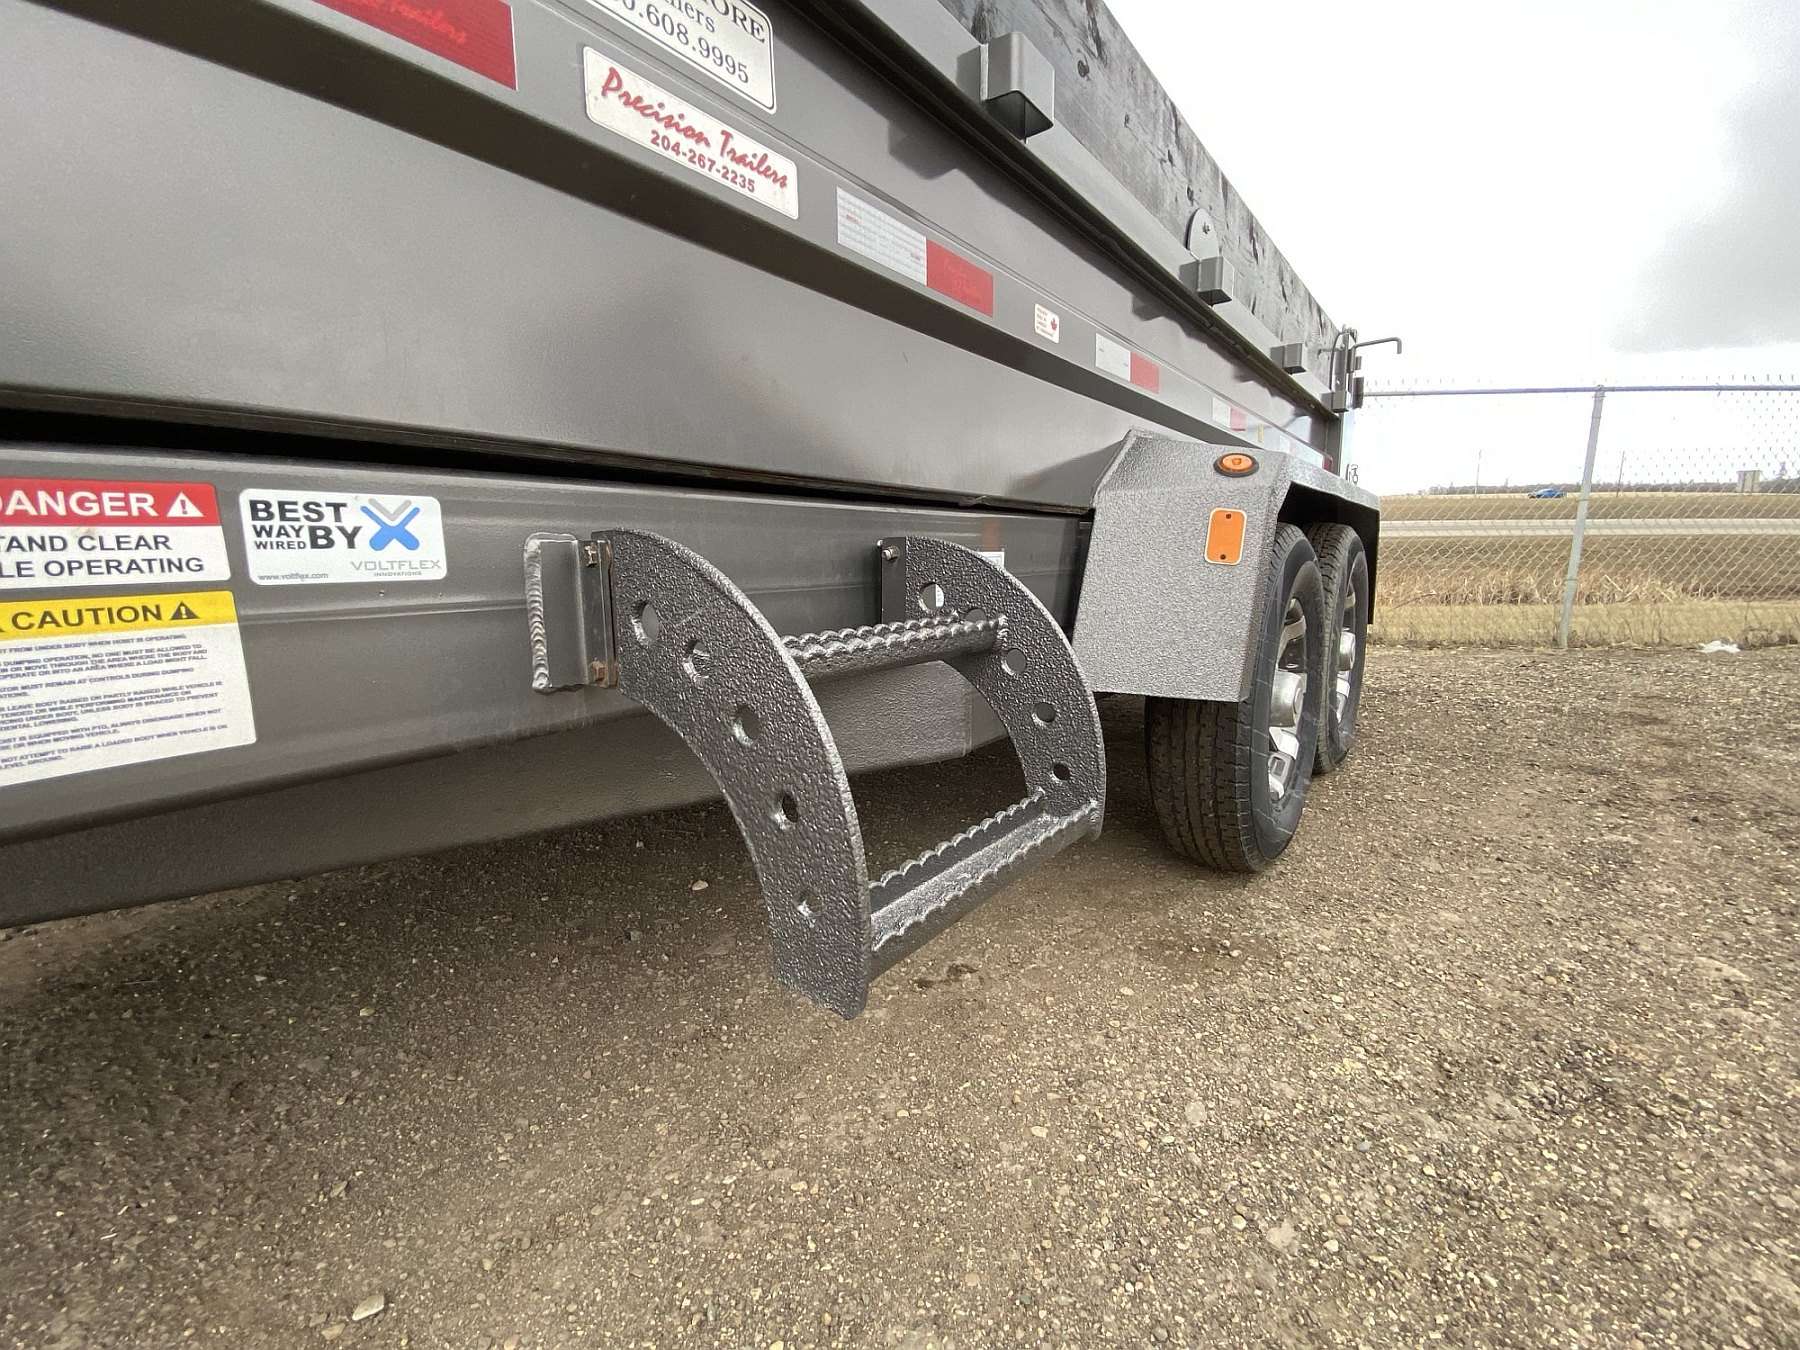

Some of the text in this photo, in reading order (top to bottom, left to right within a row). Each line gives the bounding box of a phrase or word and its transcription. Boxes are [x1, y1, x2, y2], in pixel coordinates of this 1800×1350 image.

[703, 0, 765, 43] ORE
[601, 66, 788, 189] Precision Trailers
[651, 130, 755, 193] 204-267-2235
[0, 489, 159, 517] ANGER
[249, 499, 348, 523] BEST
[78, 535, 172, 551] CLEAR
[252, 524, 363, 549] WAY BY
[255, 540, 306, 550] WIRED
[44, 557, 204, 577] OPERATING
[351, 559, 442, 571] VOLTFLEX
[11, 604, 162, 631] CAUTION
